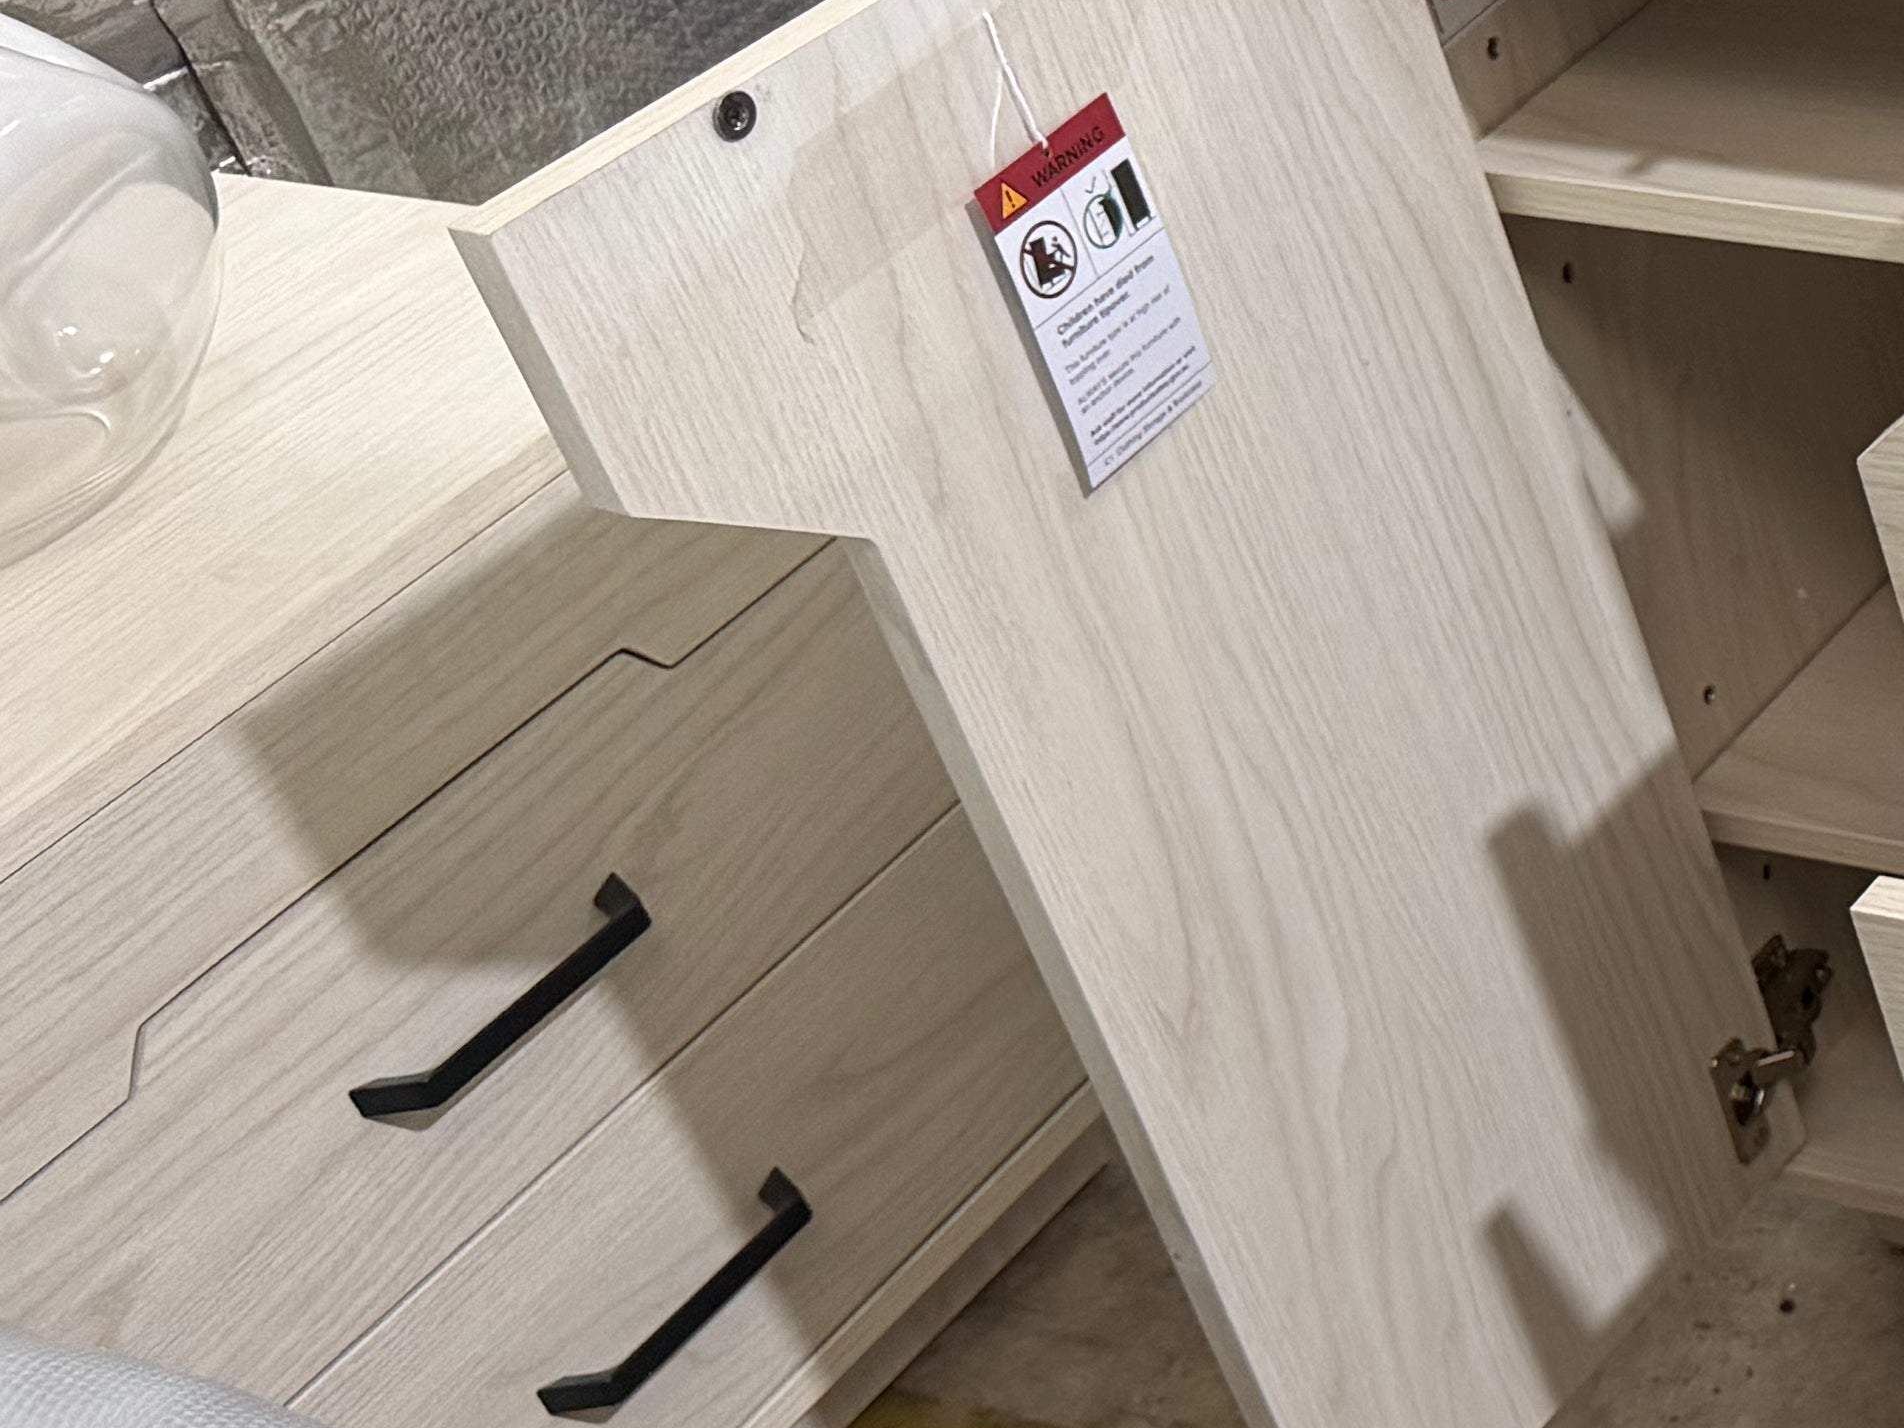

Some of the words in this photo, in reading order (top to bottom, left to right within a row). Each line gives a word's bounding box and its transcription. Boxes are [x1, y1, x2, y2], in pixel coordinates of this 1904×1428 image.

[1031, 125, 1105, 188] WARNING
[1057, 303, 1094, 335] Children
[1093, 287, 1114, 306] have
[1134, 255, 1154, 274] from
[1061, 316, 1099, 348] furniture
